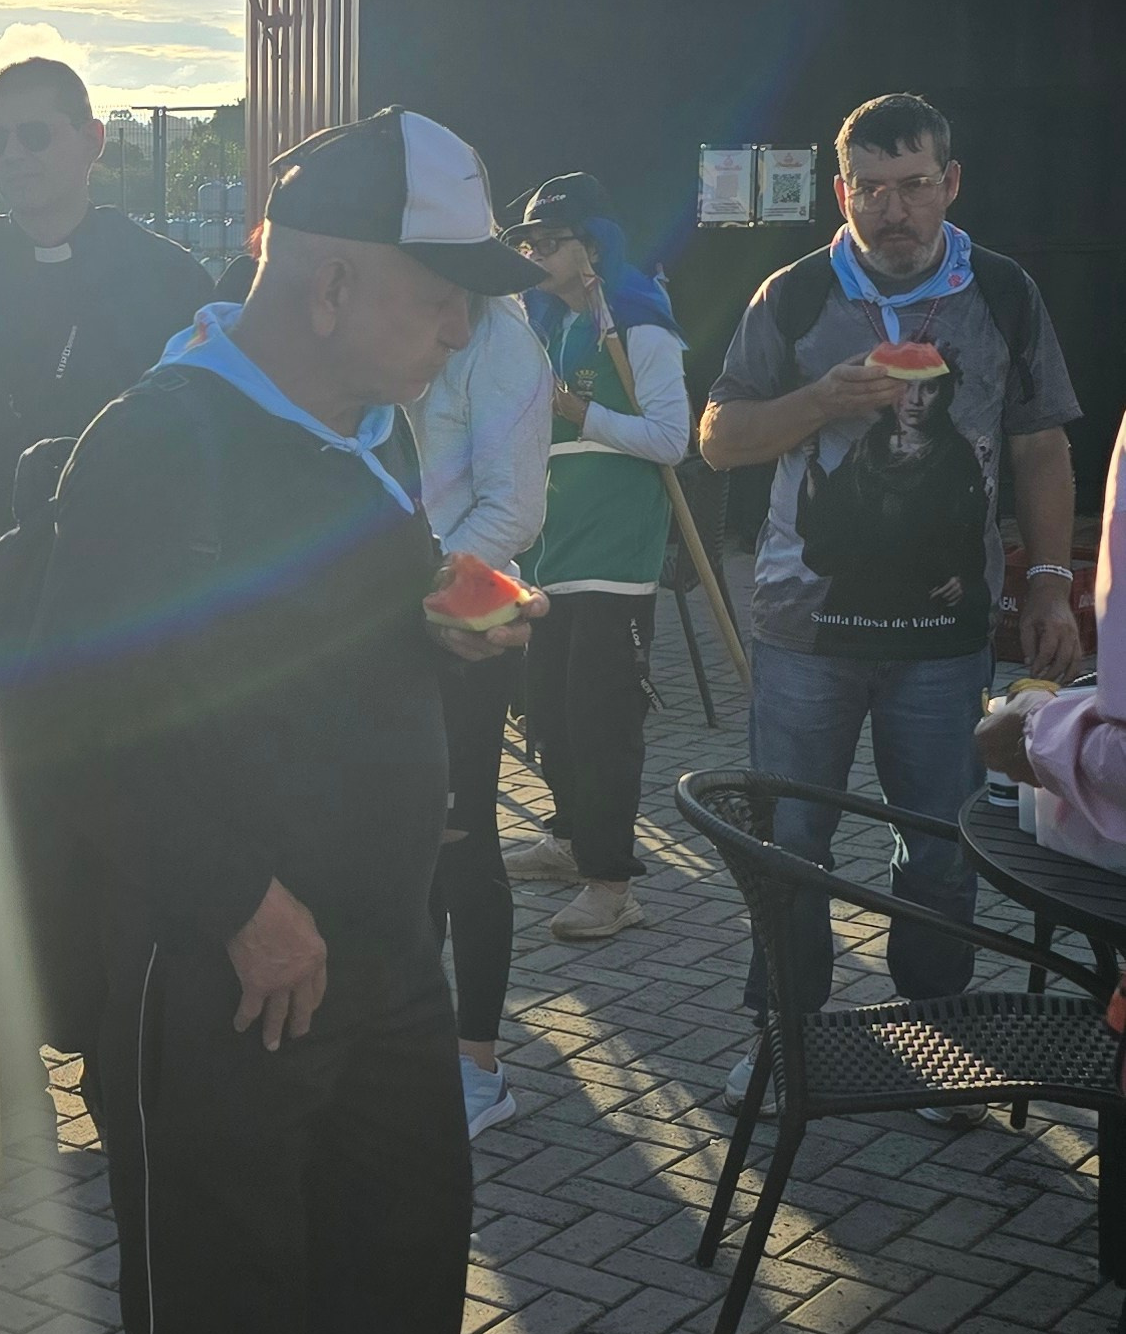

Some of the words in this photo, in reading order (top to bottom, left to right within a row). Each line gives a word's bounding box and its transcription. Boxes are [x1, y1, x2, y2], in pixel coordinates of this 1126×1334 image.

[810, 611, 849, 625] Santa
[853, 615, 888, 628] Rosa
[892, 618, 908, 628] de
[911, 614, 956, 628] Viterbo
